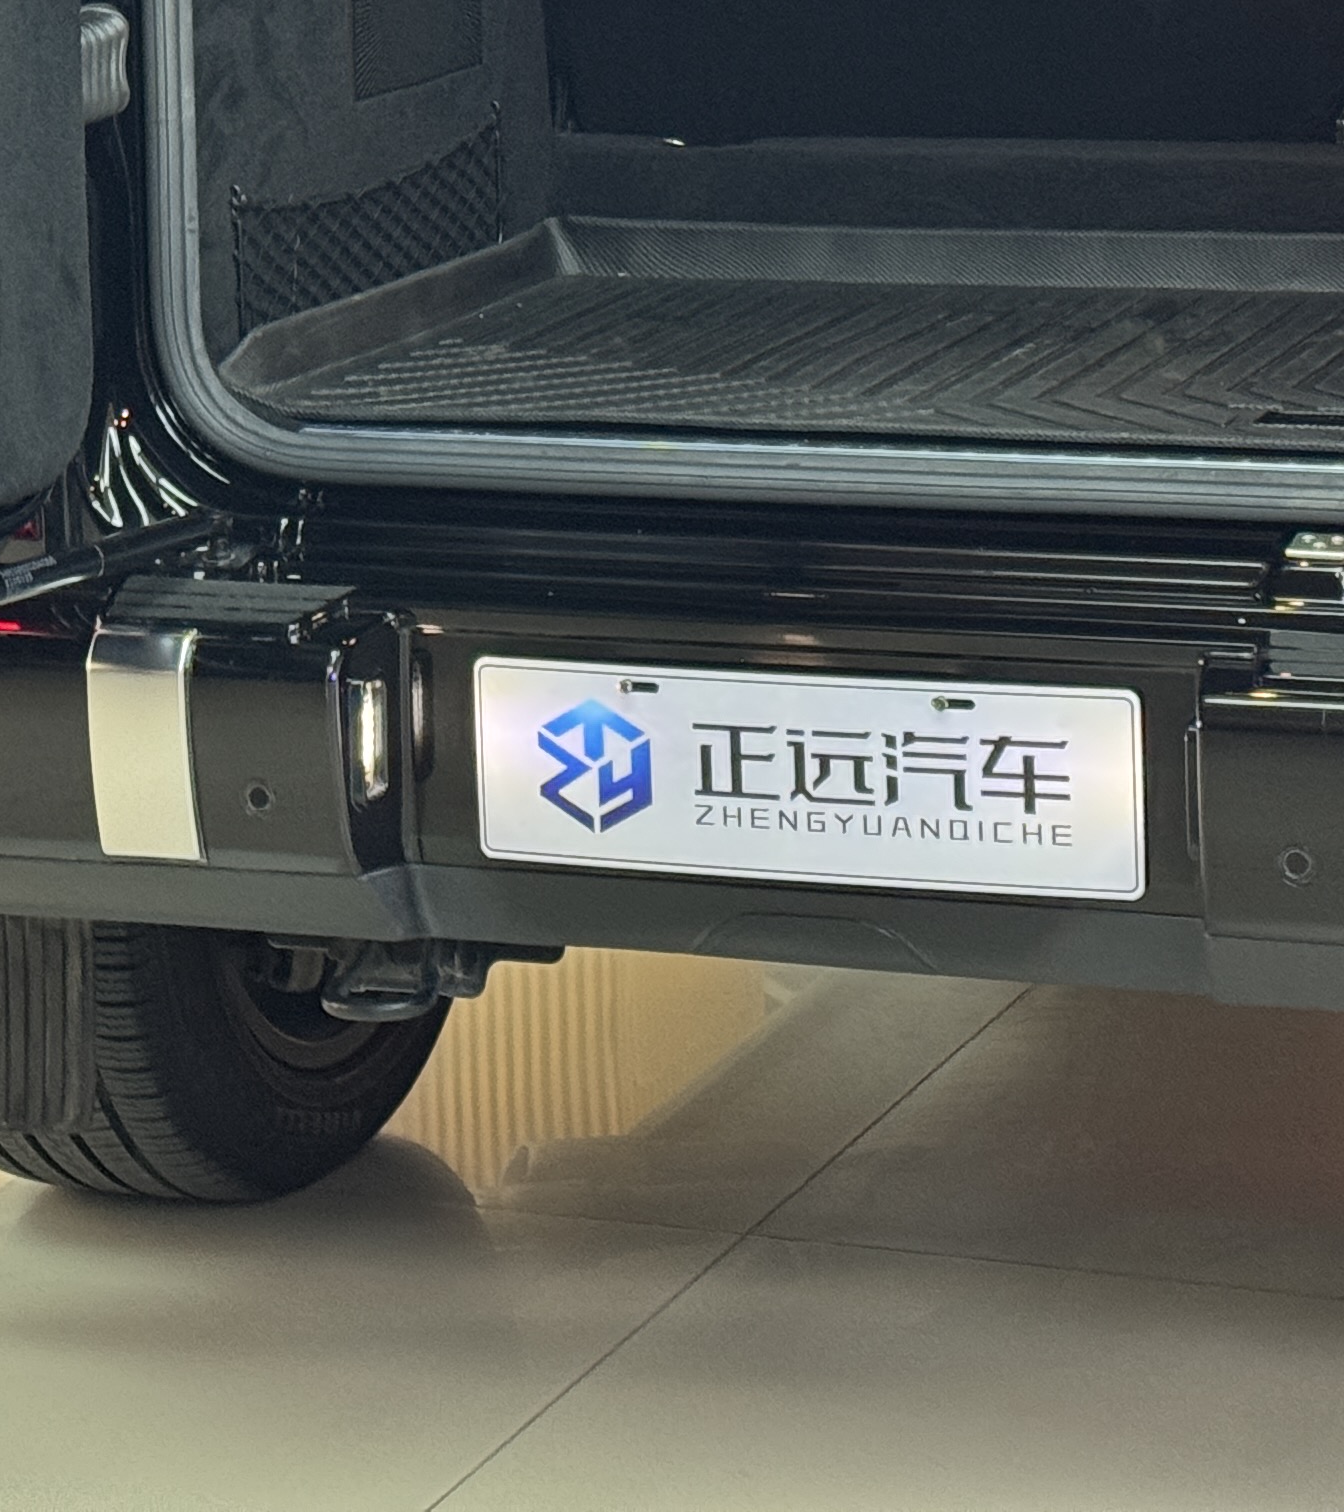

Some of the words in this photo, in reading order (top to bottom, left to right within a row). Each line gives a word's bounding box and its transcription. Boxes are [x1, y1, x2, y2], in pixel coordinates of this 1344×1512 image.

[692, 722, 1071, 815] 正远汽车
[694, 804, 1073, 846] ZHENGYUANQICHE
